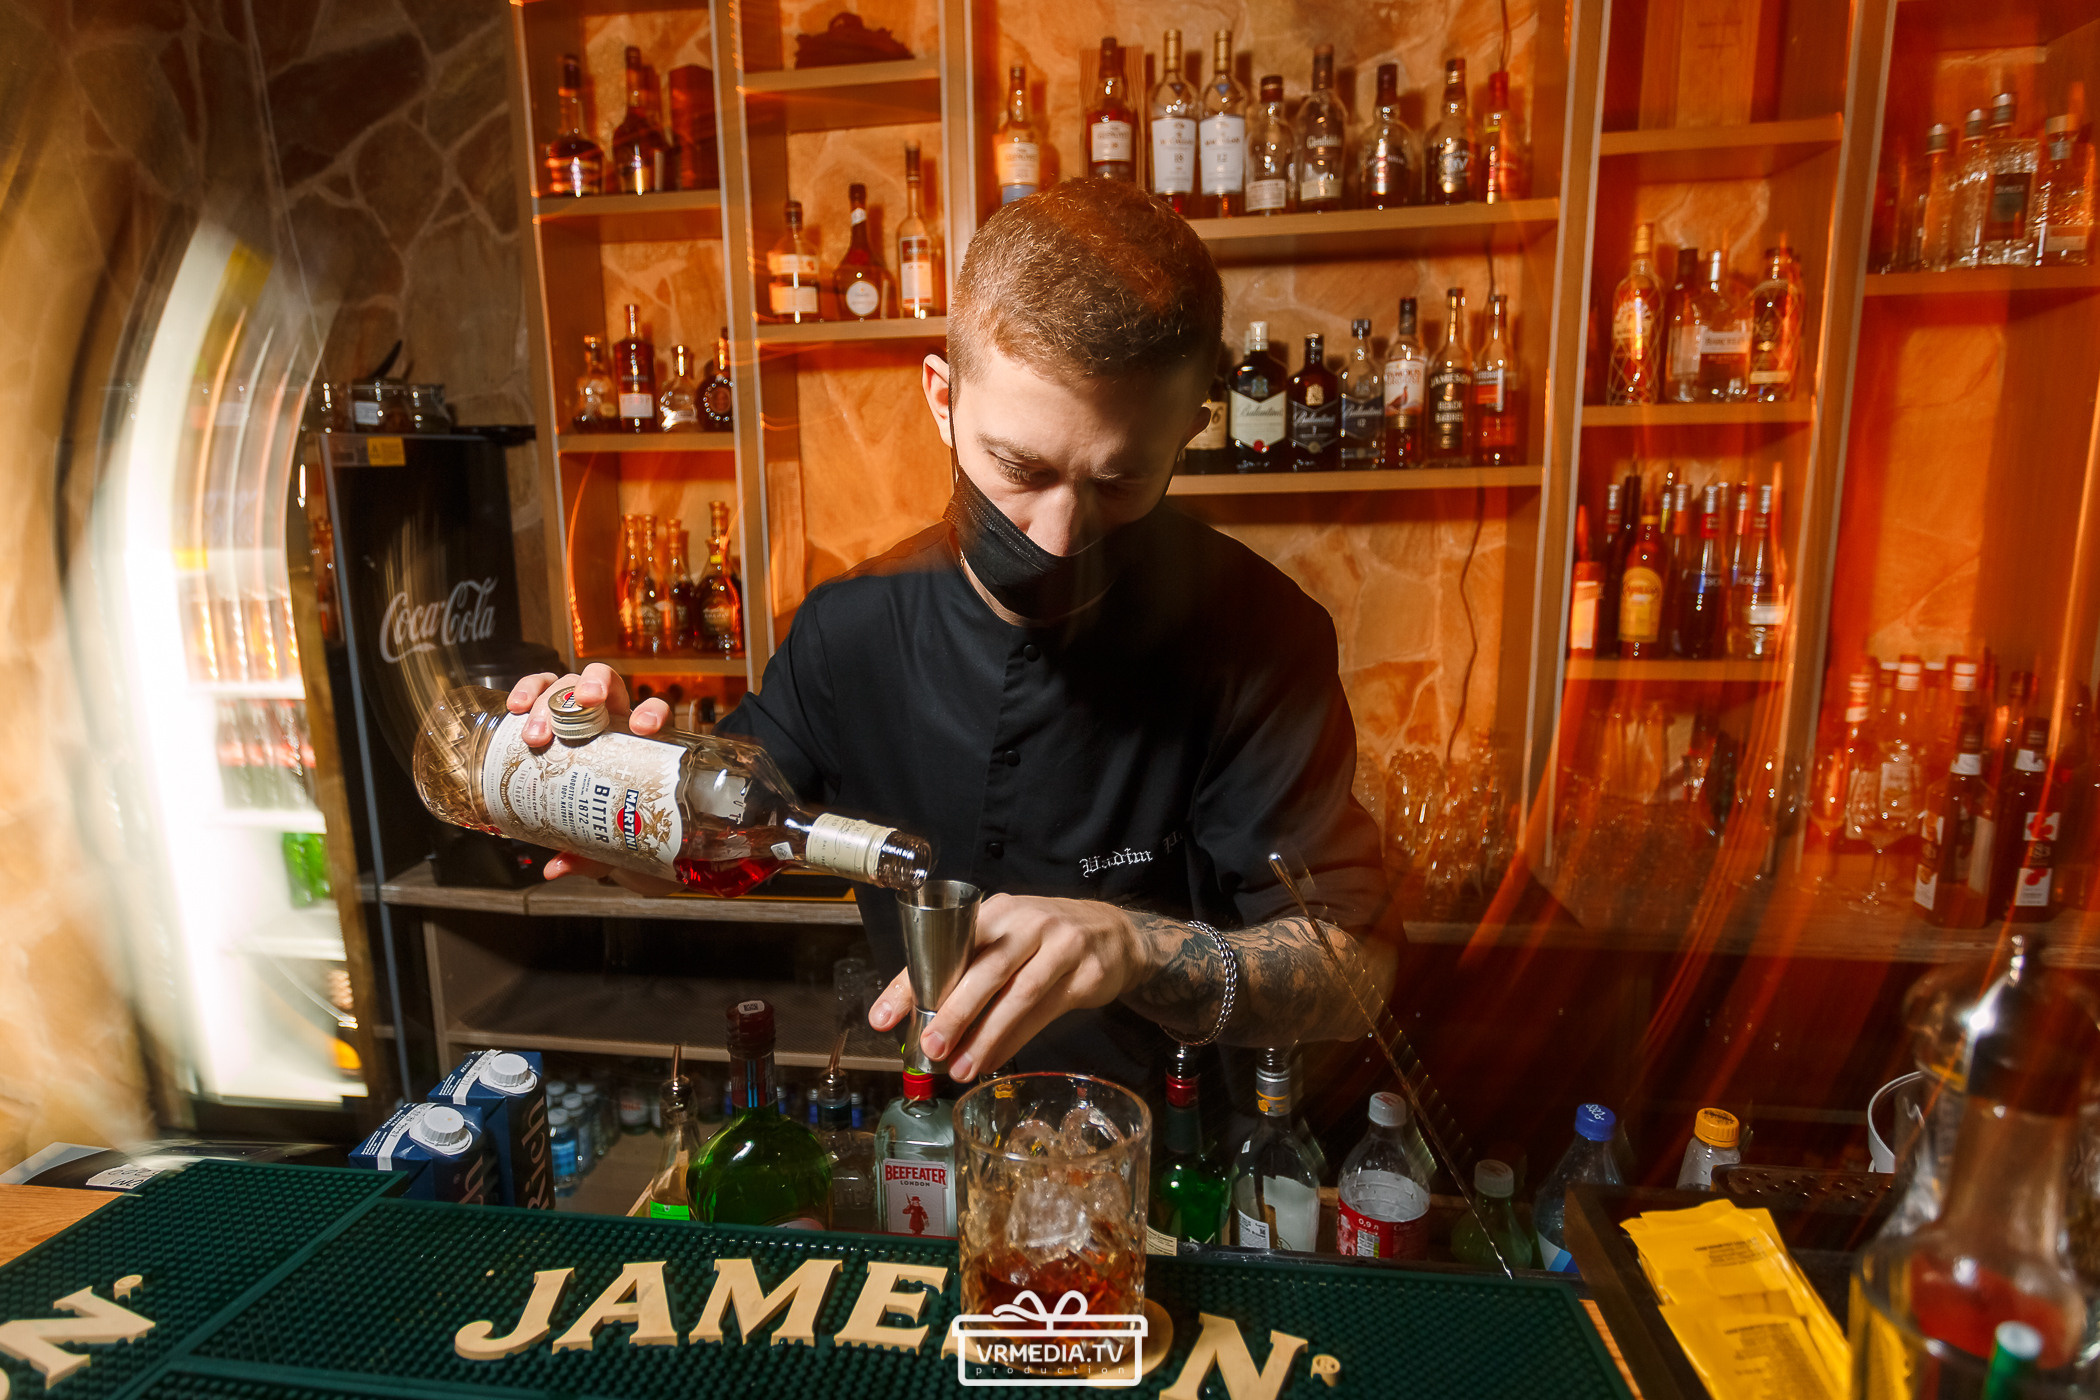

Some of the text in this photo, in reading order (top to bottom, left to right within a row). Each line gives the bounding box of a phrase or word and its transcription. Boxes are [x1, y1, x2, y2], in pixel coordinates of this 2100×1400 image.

[578, 799, 589, 825] 1872
[592, 784, 611, 844] BITTER
[624, 789, 640, 851] MARTINI
[884, 1164, 947, 1186] BEEFEATER
